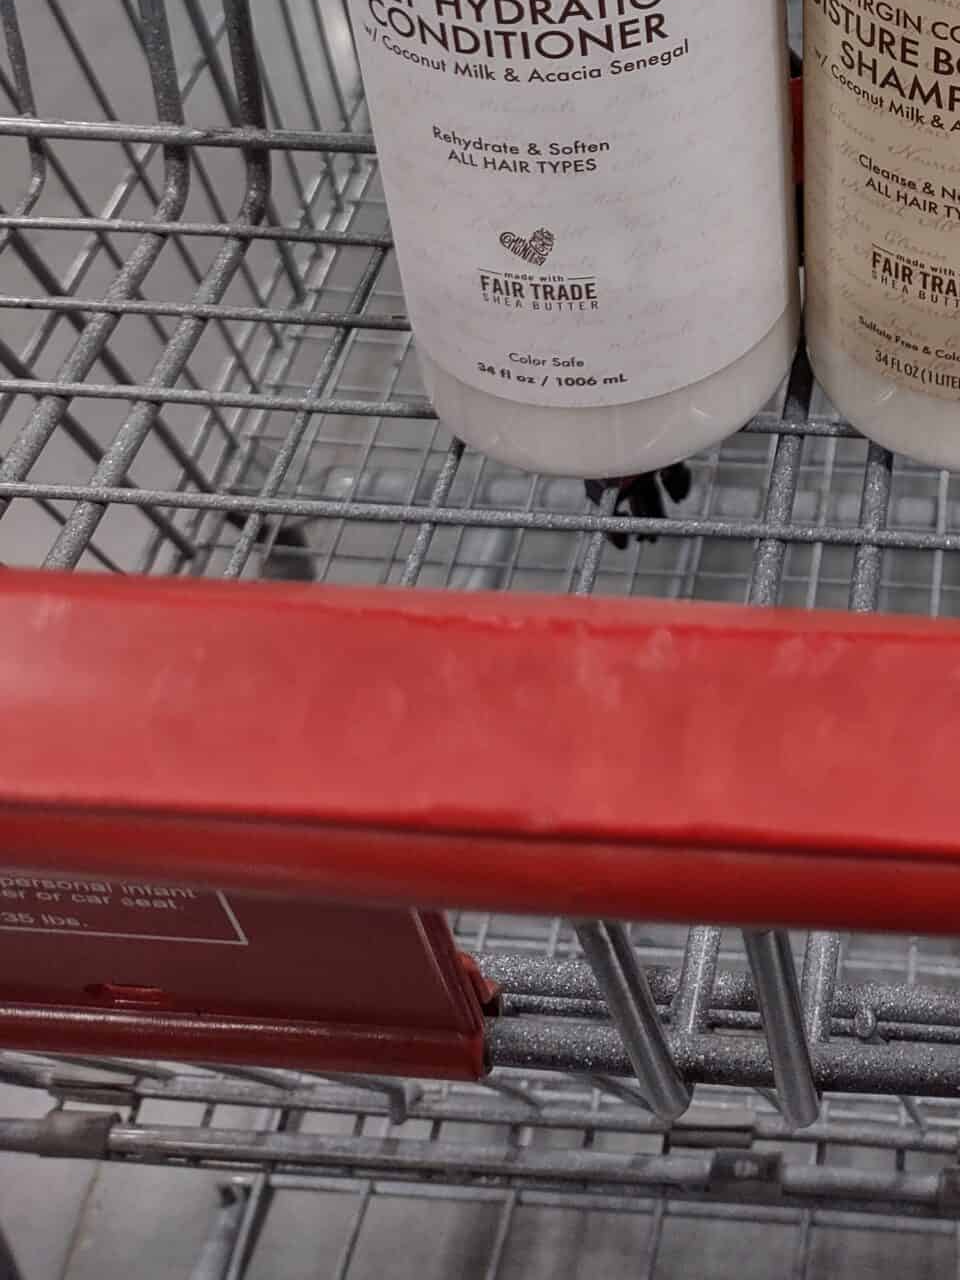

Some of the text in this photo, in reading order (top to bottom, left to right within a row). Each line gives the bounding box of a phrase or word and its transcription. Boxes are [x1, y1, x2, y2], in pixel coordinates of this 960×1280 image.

[382, 35, 447, 73] Coconut
[453, 63, 496, 81] Milk
[503, 68, 521, 83] &
[528, 66, 602, 83] Acacia
[610, 38, 689, 76] Senegal
[831, 64, 885, 105] Coconut
[888, 100, 925, 125] Milk
[930, 113, 946, 129] &
[432, 125, 610, 156] Rehydrate & Soften
[448, 149, 597, 173] ALL HAIR TYPES
[858, 153, 917, 190] Cleanse
[922, 181, 935, 197] &
[865, 177, 891, 199] ALL
[896, 190, 938, 216] HAIR
[504, 271, 565, 282] made with
[871, 250, 913, 285] FAIR
[480, 275, 597, 301] FAIR TRADE
[871, 270, 909, 295] SHEA
[482, 292, 600, 311] SHEA BUTTER
[895, 335, 919, 352] Free
[922, 345, 932, 356] &
[508, 352, 585, 369] Color Safe
[875, 350, 889, 366] 34
[890, 356, 902, 373] FL
[903, 362, 919, 379] OZ
[516, 374, 536, 385] oz
[556, 375, 598, 387] 1006
[35, 891, 62, 902] or
[71, 893, 112, 905] car
